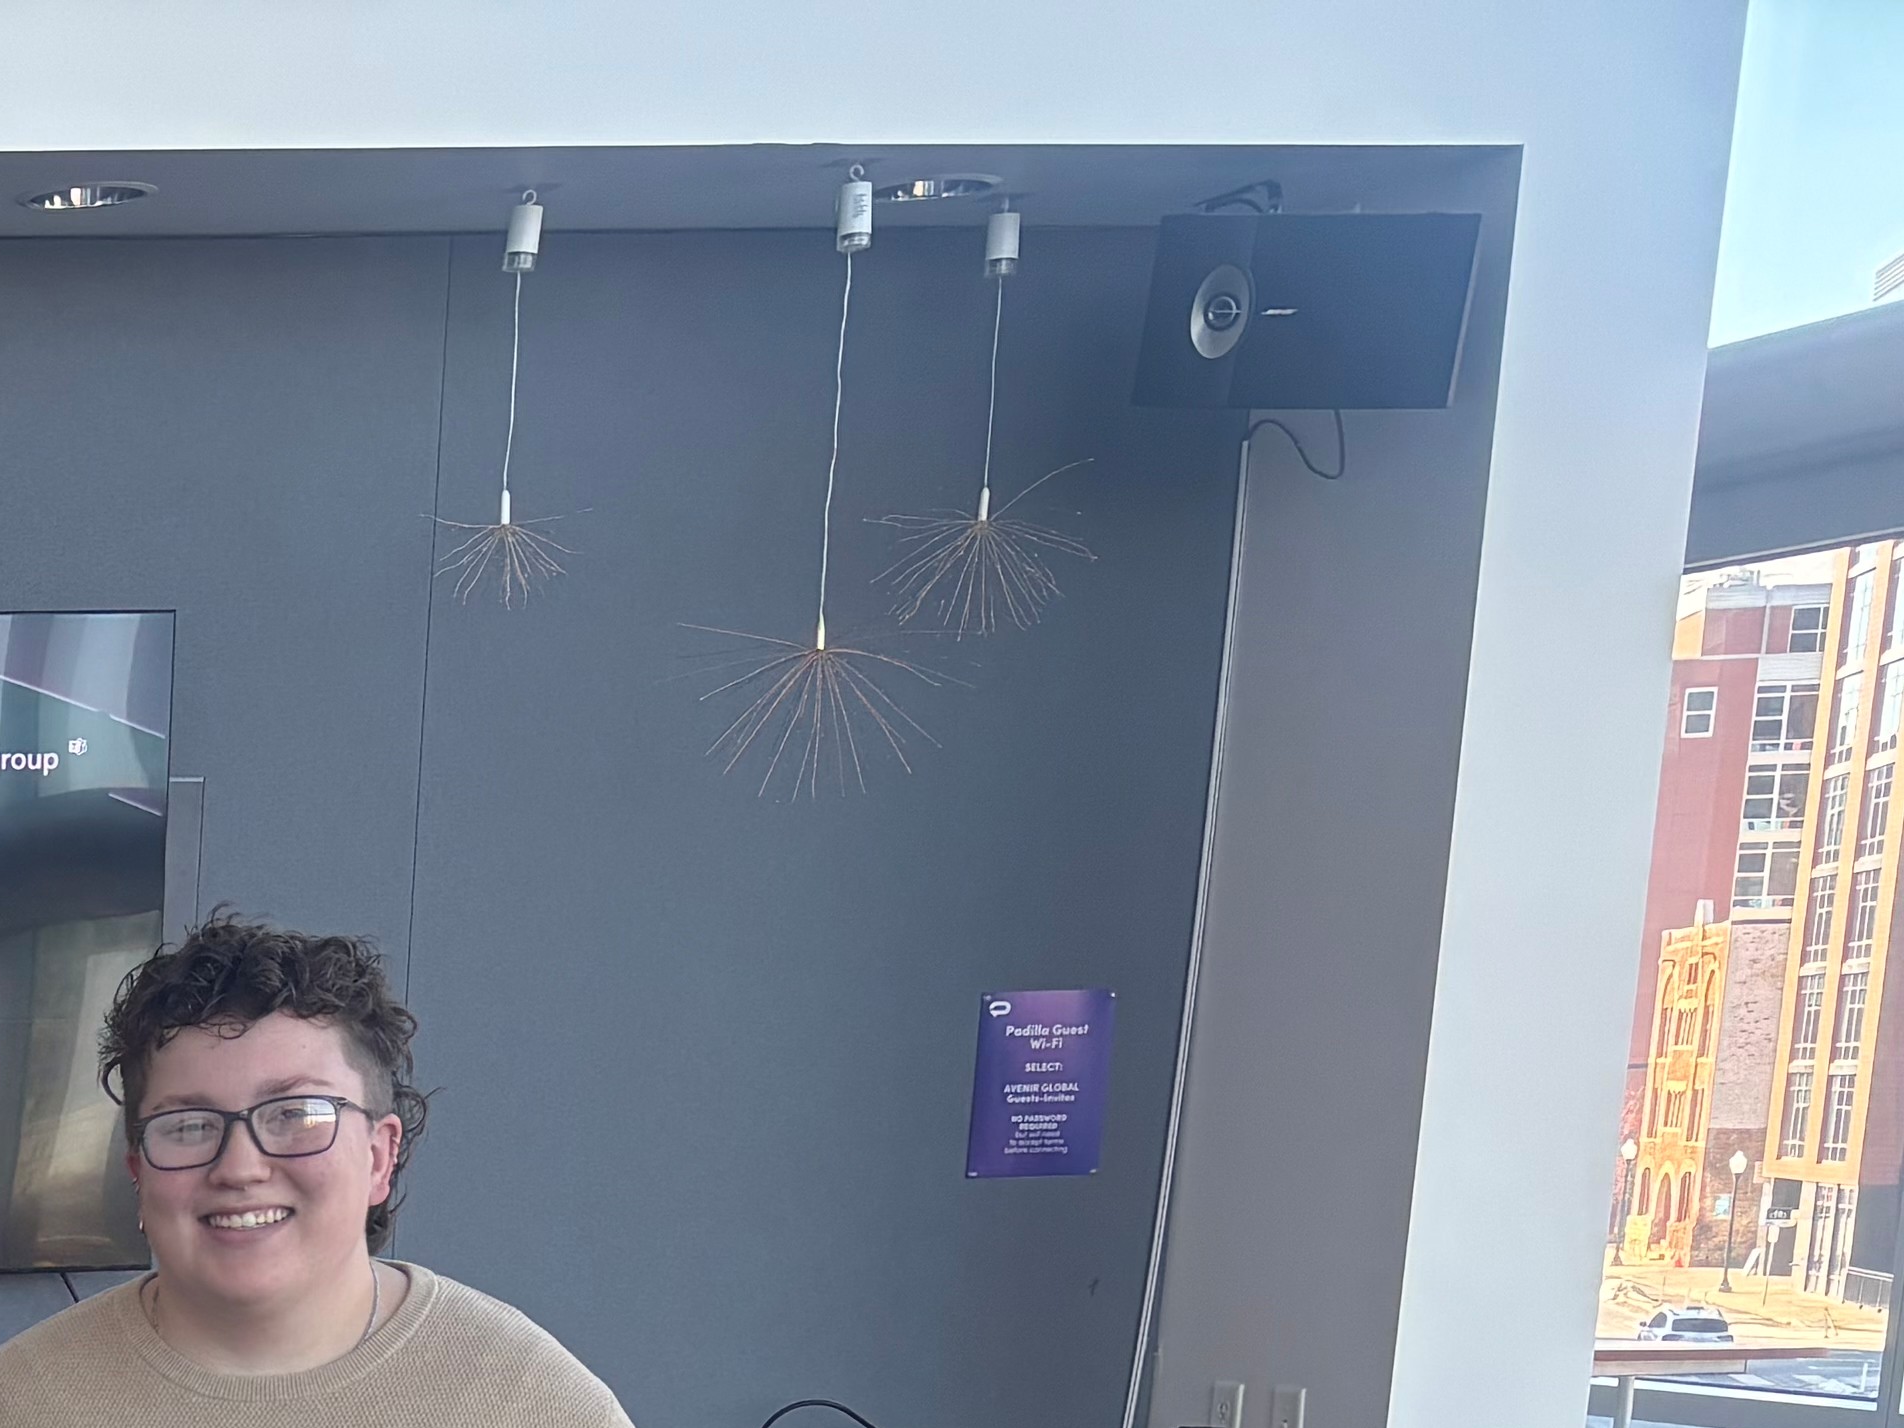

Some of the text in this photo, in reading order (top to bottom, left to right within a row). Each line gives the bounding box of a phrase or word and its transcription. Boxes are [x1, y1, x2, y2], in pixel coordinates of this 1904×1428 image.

[1005, 1024, 1089, 1037] Padilla Guest
[1030, 1037, 1063, 1049] Wi-Fi
[1003, 1082, 1080, 1093] AVENIR GLOBAL
